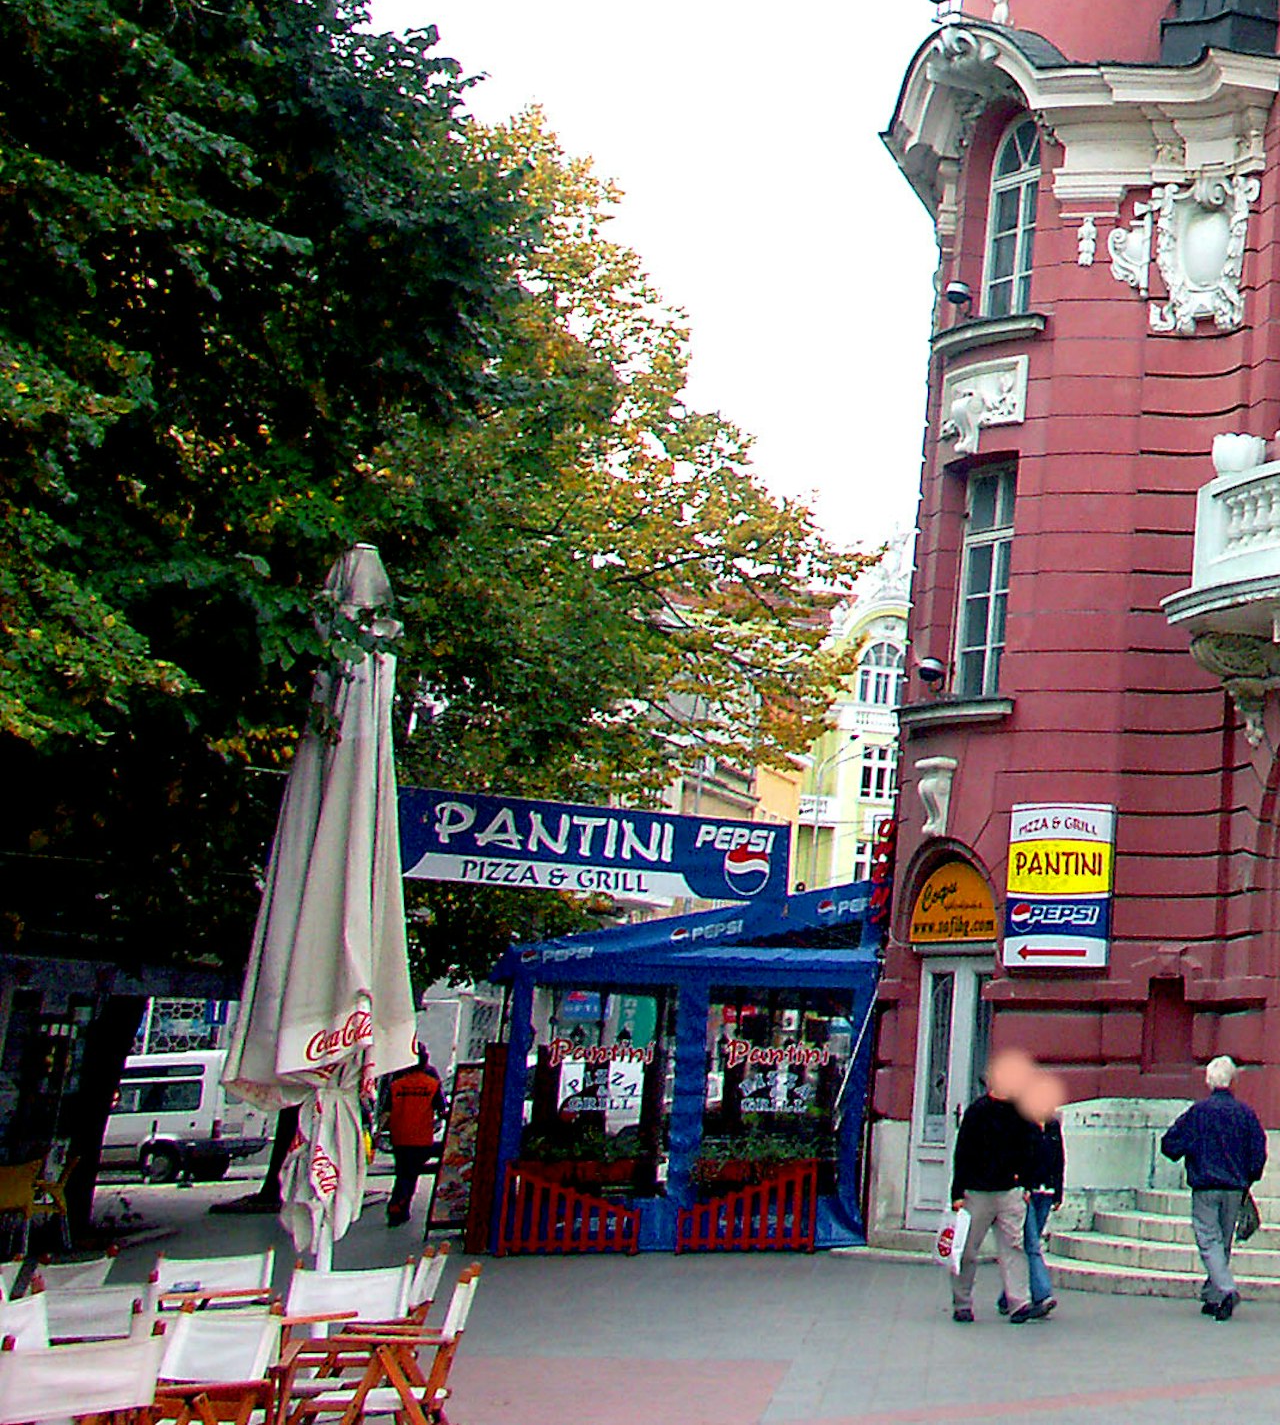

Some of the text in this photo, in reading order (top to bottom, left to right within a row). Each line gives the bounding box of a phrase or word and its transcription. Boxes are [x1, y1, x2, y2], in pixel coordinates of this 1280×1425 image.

[433, 800, 676, 864] PANTINI
[694, 823, 776, 855] PEPSI
[1018, 816, 1098, 835] PIZZA & GRILL
[460, 859, 650, 894] PIZZA & GRILL
[1016, 851, 1103, 876] PANTINI
[1028, 905, 1100, 925] PEPSI
[690, 920, 744, 942] PEPSI
[541, 946, 594, 964] PEPSI
[549, 1038, 655, 1067] Pantini
[727, 1038, 830, 1068] Pantini
